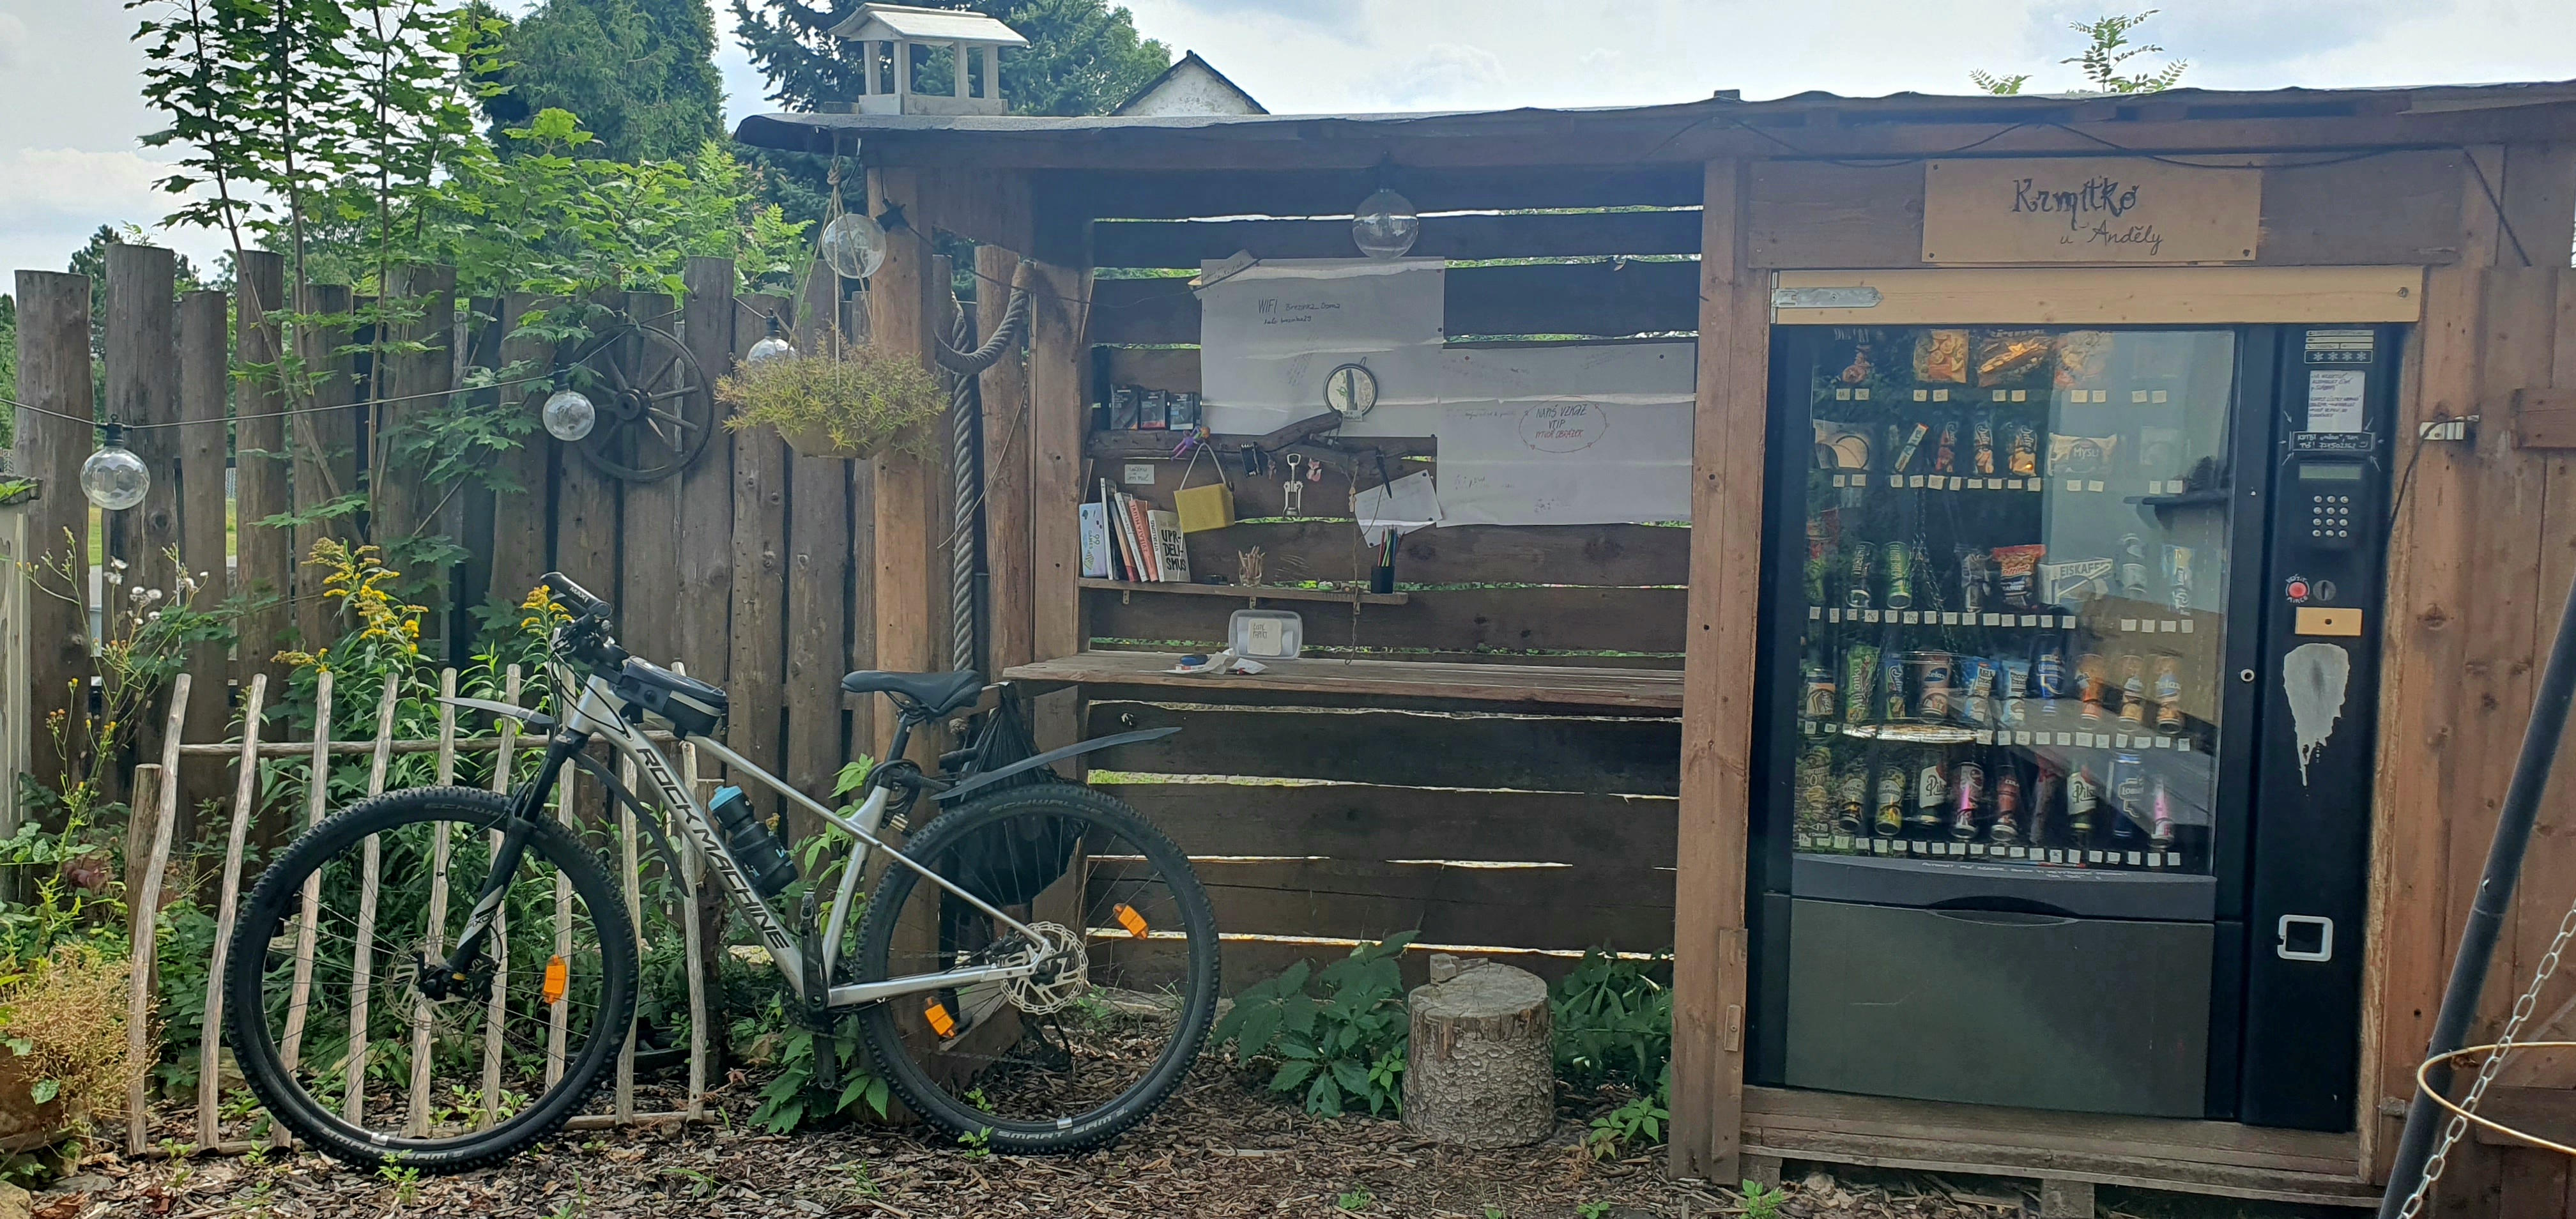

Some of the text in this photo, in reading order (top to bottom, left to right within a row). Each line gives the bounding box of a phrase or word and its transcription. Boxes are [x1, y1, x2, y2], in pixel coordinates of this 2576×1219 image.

[2060, 220, 2163, 255] u Anděly
[1258, 296, 1278, 314] WIFI
[1093, 534, 1100, 545] 99
[1162, 530, 1181, 543] UPR-
[1163, 543, 1184, 557] DELI-
[1167, 558, 1186, 571] SMUS
[2060, 562, 2108, 576] EISKAFF
[636, 748, 791, 950] ROCK MACHINE
[997, 1116, 1112, 1140] SMART SAM
